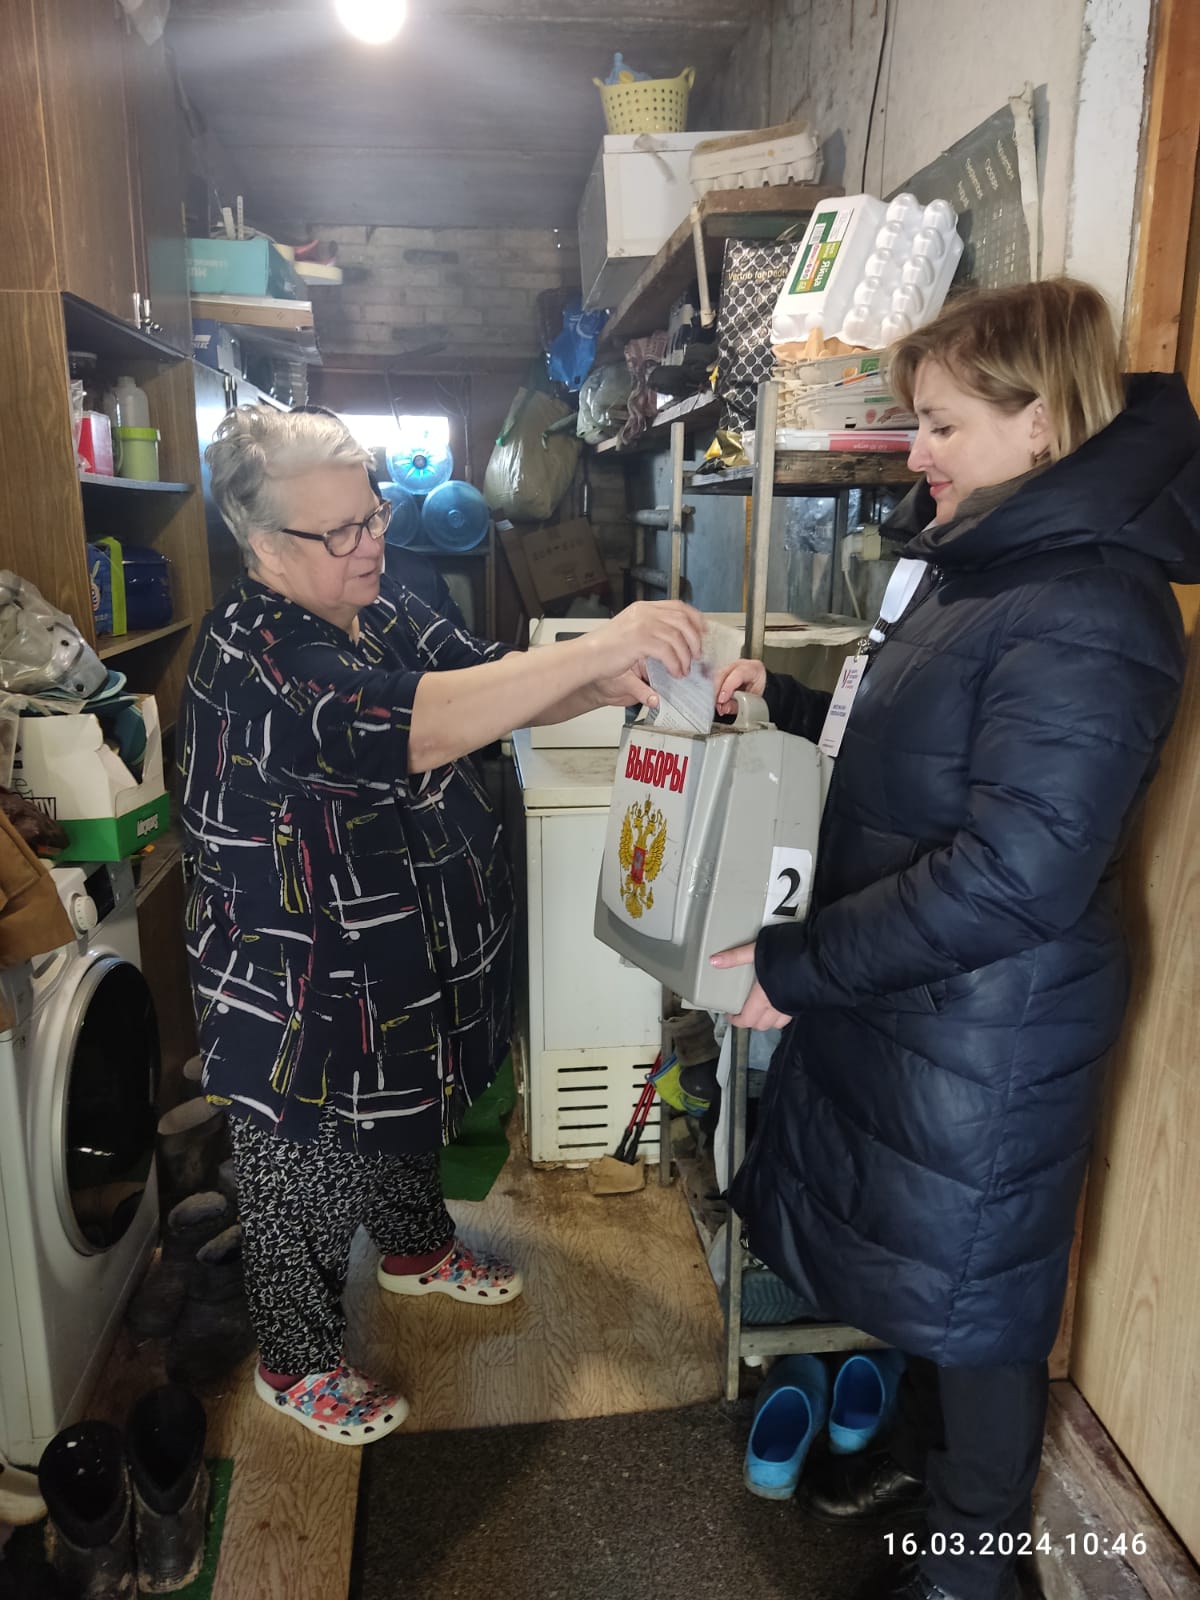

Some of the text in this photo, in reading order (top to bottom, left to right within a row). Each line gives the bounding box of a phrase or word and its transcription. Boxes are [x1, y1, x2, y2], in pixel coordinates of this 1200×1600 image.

[813, 260, 831, 287] Яйца
[625, 744, 689, 794] ВЫБОРЫ
[772, 867, 800, 917] 2
